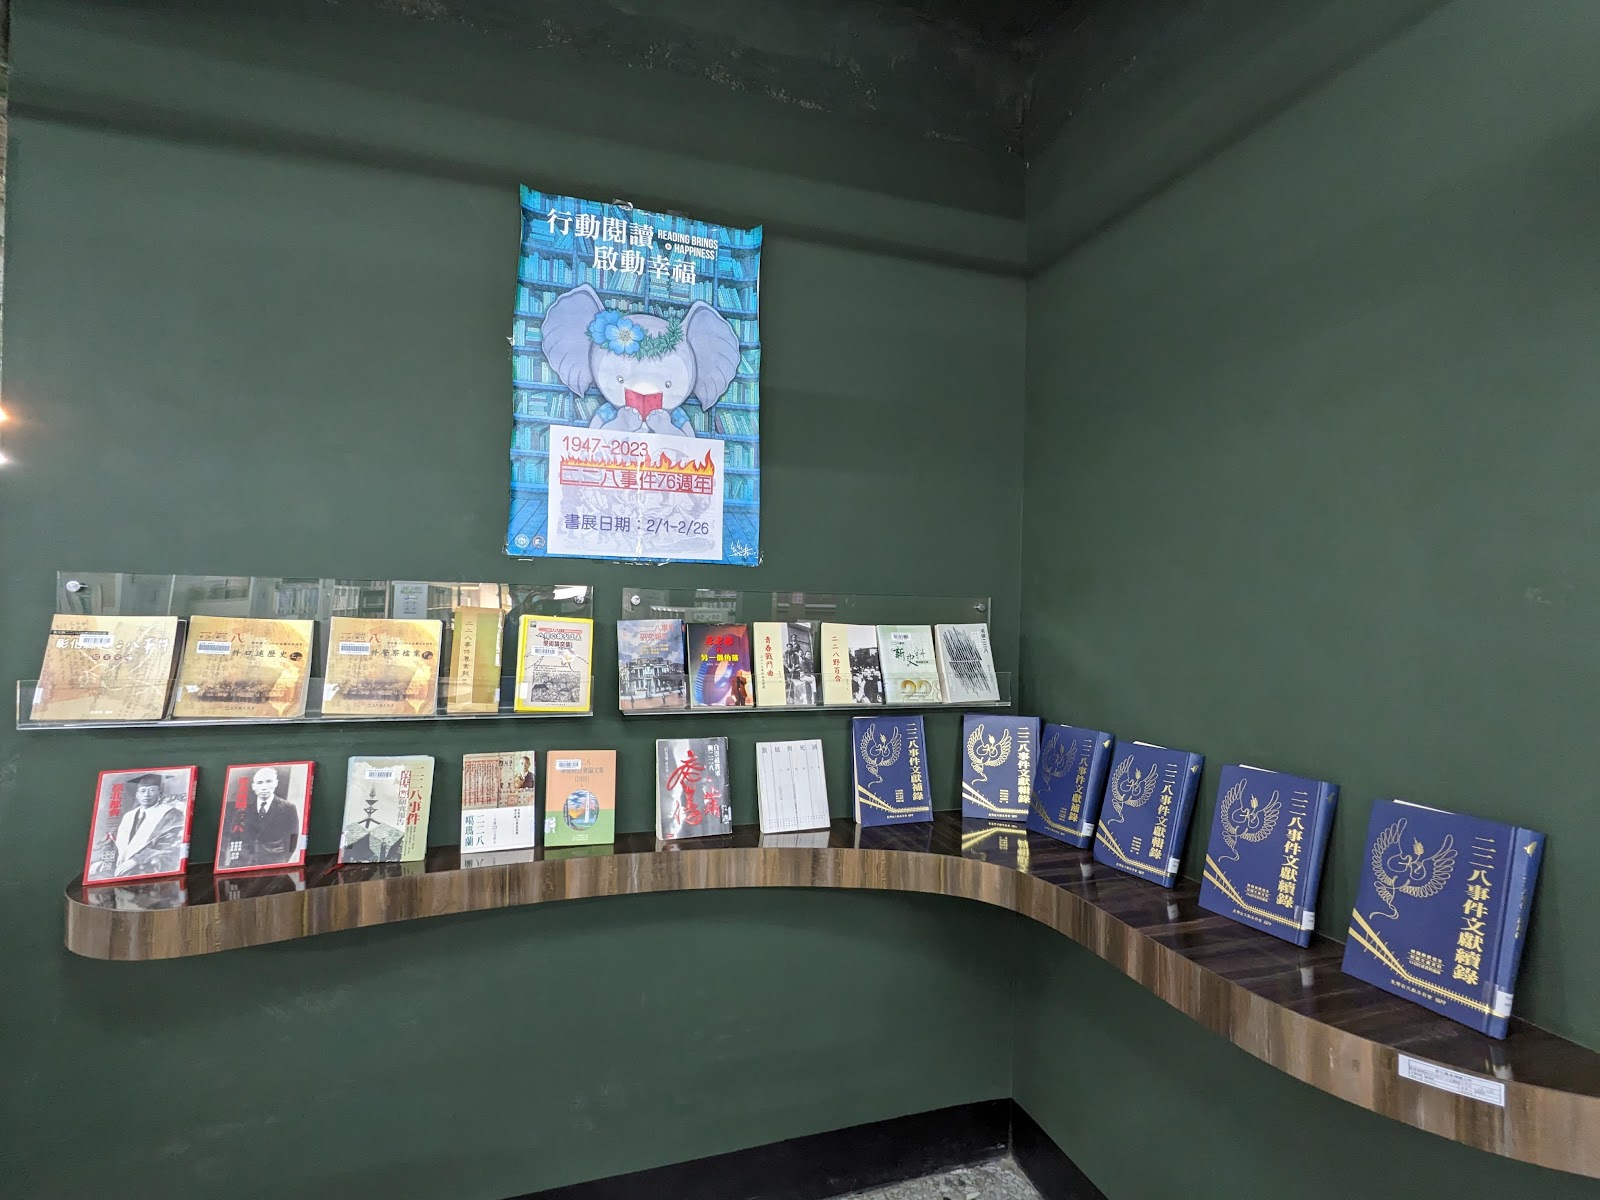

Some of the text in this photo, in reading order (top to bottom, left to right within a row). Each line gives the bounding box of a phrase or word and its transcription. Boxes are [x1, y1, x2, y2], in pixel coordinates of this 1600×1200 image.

[546, 208, 654, 250] 行動閱讀
[657, 229, 719, 249] READING BRINGS
[592, 245, 697, 285] 啟動幸福
[562, 435, 649, 457] 1947-2023
[561, 467, 713, 493] 二二八事件76週年
[406, 766, 425, 825] 二二八事件
[1276, 791, 1308, 909] 二二八事件文獻續錄
[1453, 836, 1496, 985] 二二八事件文獻續錄
